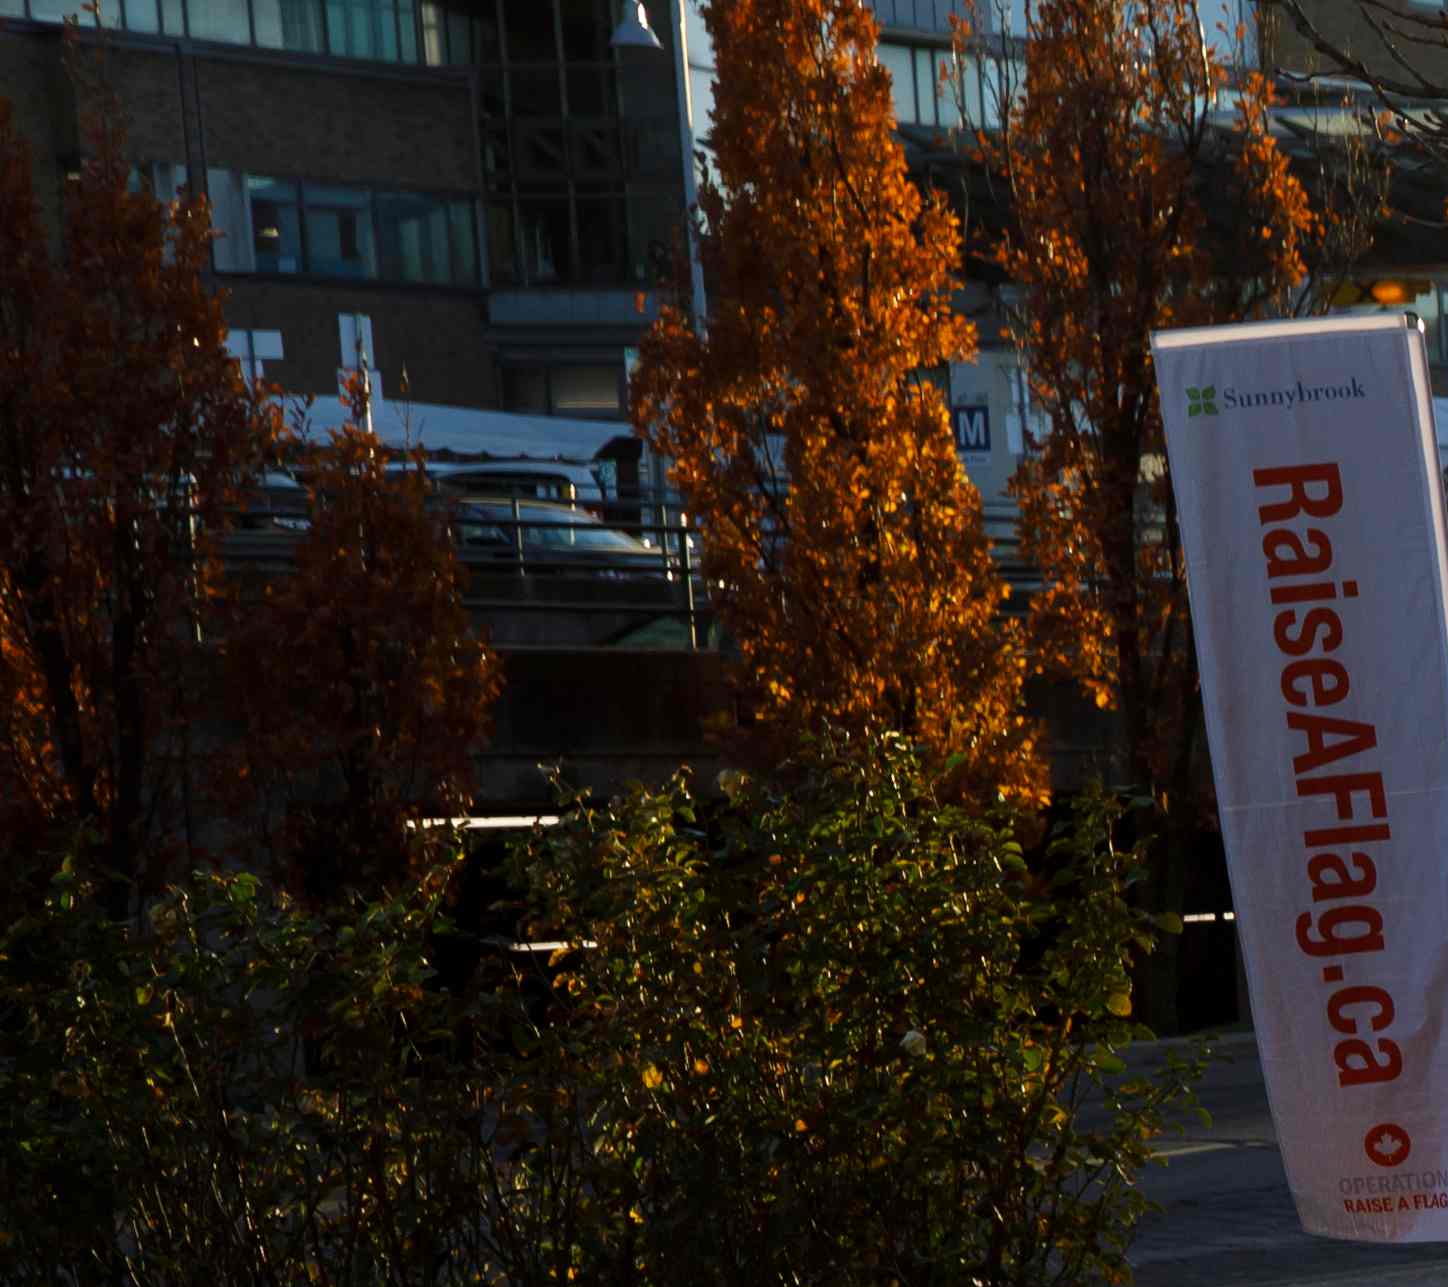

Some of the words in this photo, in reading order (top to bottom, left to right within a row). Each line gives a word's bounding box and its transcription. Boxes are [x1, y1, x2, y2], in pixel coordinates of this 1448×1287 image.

[1223, 377, 1366, 409] Sunnybrook
[958, 411, 986, 446] M
[1252, 463, 1403, 1088] RaiseAFlag.ca
[1338, 1170, 1448, 1195] OPERATION
[1344, 1197, 1393, 1213] RAISE
[1398, 1196, 1410, 1211] A
[1414, 1193, 1448, 1209] FLAG
